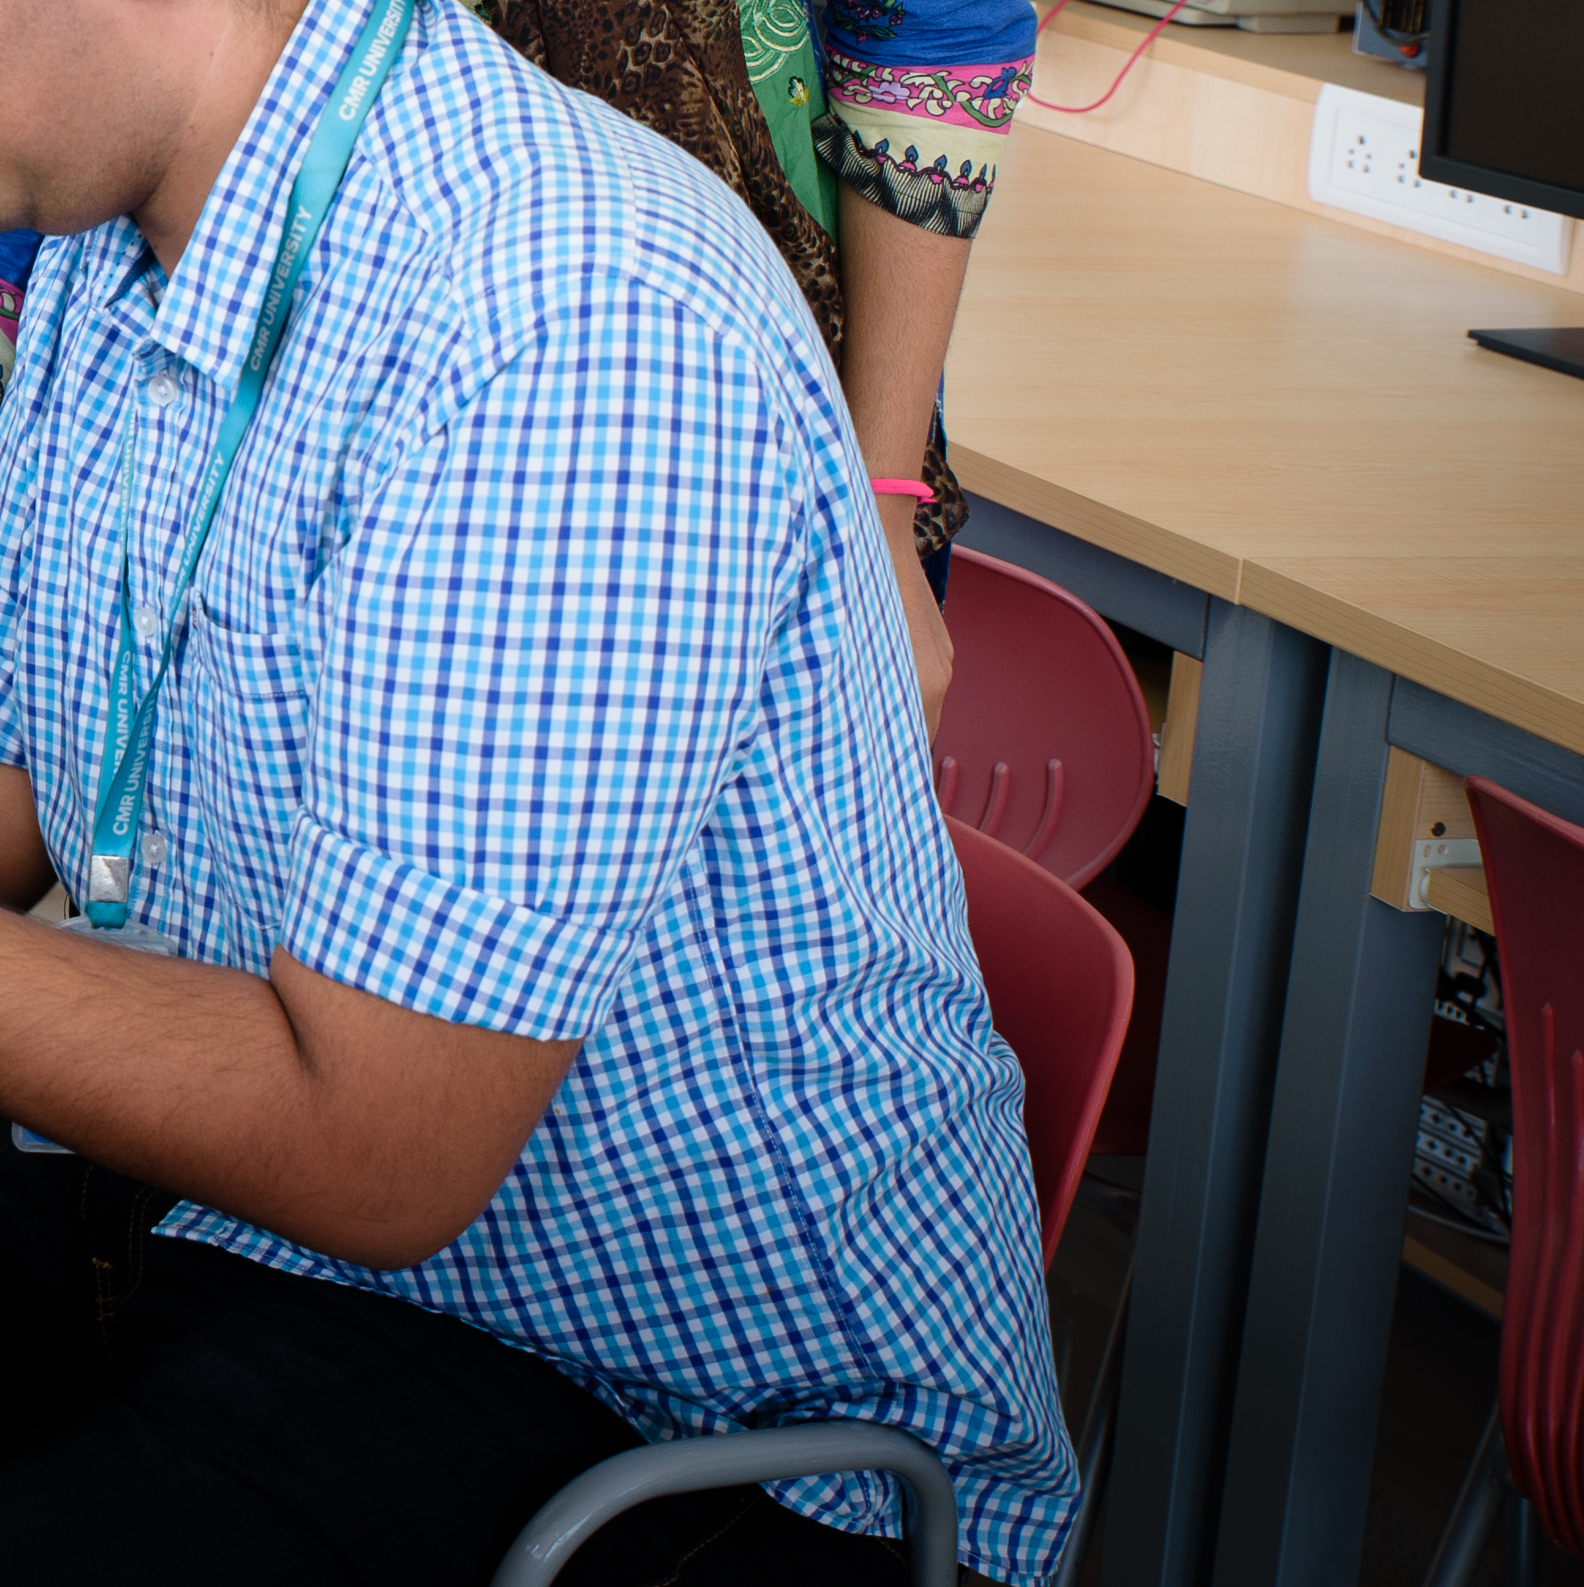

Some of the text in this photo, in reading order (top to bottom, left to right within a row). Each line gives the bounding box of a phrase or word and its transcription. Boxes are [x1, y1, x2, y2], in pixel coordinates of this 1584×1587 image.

[338, 80, 374, 123] CMR
[248, 202, 314, 373] CMR UNIVERSITY
[181, 450, 225, 568] UNIVERSITY
[117, 650, 132, 695] CMR
[111, 793, 137, 837] CMR
